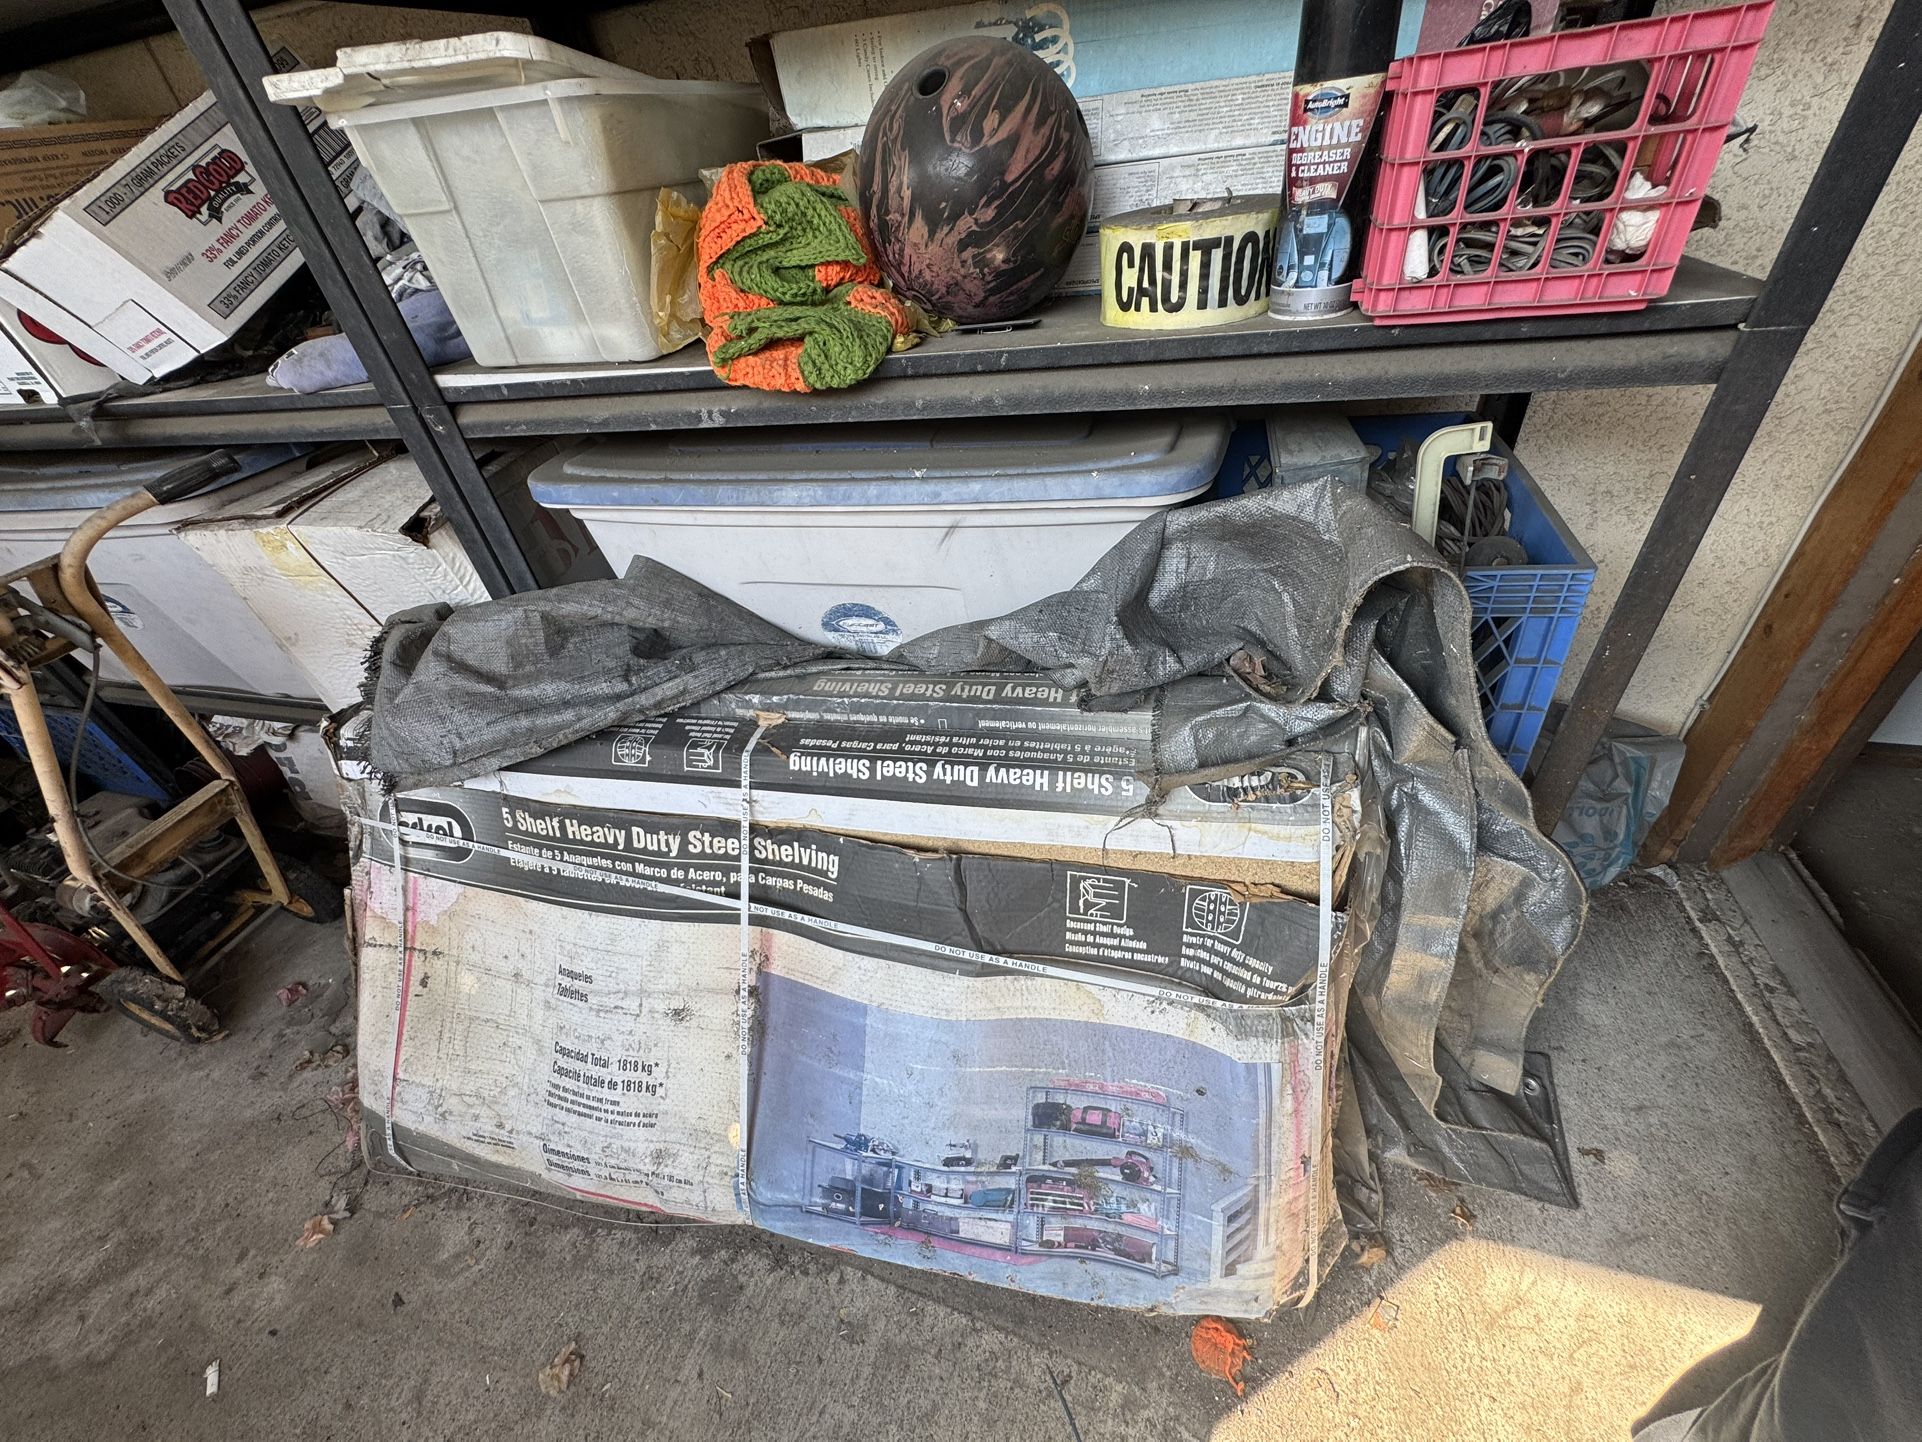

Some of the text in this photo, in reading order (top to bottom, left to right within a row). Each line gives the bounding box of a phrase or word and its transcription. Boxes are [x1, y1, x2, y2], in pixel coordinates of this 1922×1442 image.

[861, 42, 869, 62] Candy
[1306, 97, 1345, 109] AutoBright
[1290, 119, 1363, 147] ENGINE
[1292, 149, 1350, 165] DEGREASER
[97, 190, 126, 217] 1,000
[124, 182, 134, 194] 7
[129, 164, 158, 189] GRAM
[149, 140, 187, 173] PACKETS
[1291, 163, 1348, 177] & CLEANER
[166, 149, 245, 218] RED GOLD
[210, 182, 238, 208] QUALITY
[199, 199, 268, 264] 33% FANCY TOMATO
[222, 254, 238, 270] FOIL
[232, 243, 250, 261] LINED
[244, 227, 268, 250] PORTION
[218, 290, 239, 310] 33%
[231, 270, 258, 296] FANCY
[250, 247, 282, 276] TOMATO
[1114, 227, 1277, 313] CAUTION
[1313, 301, 1321, 309] WT
[811, 676, 1063, 705] Heavy Duty Steel Shelving
[878, 714, 886, 723] en
[888, 713, 906, 725] monte
[908, 716, 918, 726] Se
[977, 716, 1025, 731] verticalement
[1027, 721, 1035, 729] ou
[1038, 718, 1096, 735] horizontalement
[904, 730, 950, 746] résistant
[952, 735, 976, 746] ultra
[978, 736, 1005, 748] acier
[1007, 738, 1021, 748] en
[1023, 736, 1072, 755] tablettes
[1074, 743, 1081, 752] 5
[799, 735, 1135, 768] Estante de 5 Anaqueles con Marco de Acero, para Cargas Pesadas
[1083, 744, 1091, 753] à
[788, 746, 865, 783] Shelving
[875, 757, 928, 789] Steel
[931, 757, 979, 788] Duty
[981, 760, 1050, 794] Heavy
[1054, 767, 1114, 798] Shelf
[1119, 775, 1134, 795] 5
[742, 791, 748, 800] AS
[477, 844, 500, 854] HANDLE
[499, 807, 841, 879] 5 Shelf Heavy Duty Stee Shelving
[742, 843, 747, 855] DO
[506, 841, 836, 902] Estante de 5 Anaqueles con Marco de Acero, paa Cargas Pesadas
[1086, 933, 1094, 942] de
[1095, 935, 1119, 945] Anaquel
[1095, 922, 1111, 933] Shelf
[1112, 925, 1134, 936] Design
[933, 944, 946, 952] DO
[948, 947, 966, 956] NOT
[968, 951, 985, 960] USE
[988, 955, 1000, 963] AS
[1011, 960, 1047, 973] HANDLE
[1065, 944, 1097, 955] Conception
[1182, 932, 1274, 974] Rivets for heavy duty capacity
[558, 963, 593, 985] Anaqueles
[1209, 953, 1224, 966] para
[1221, 960, 1253, 980] capacidad
[1251, 973, 1262, 984] de
[556, 982, 589, 1004] Tablettes
[552, 1041, 590, 1064] Capacidad
[589, 1052, 610, 1068] Total
[617, 1057, 640, 1074] 1818
[551, 1060, 582, 1082] Capacité
[581, 1070, 606, 1088] totale
[606, 1077, 618, 1090] de
[619, 1078, 643, 1094] 1818
[540, 1142, 592, 1164] Dimensiones
[544, 1158, 592, 1176] Dimensions
